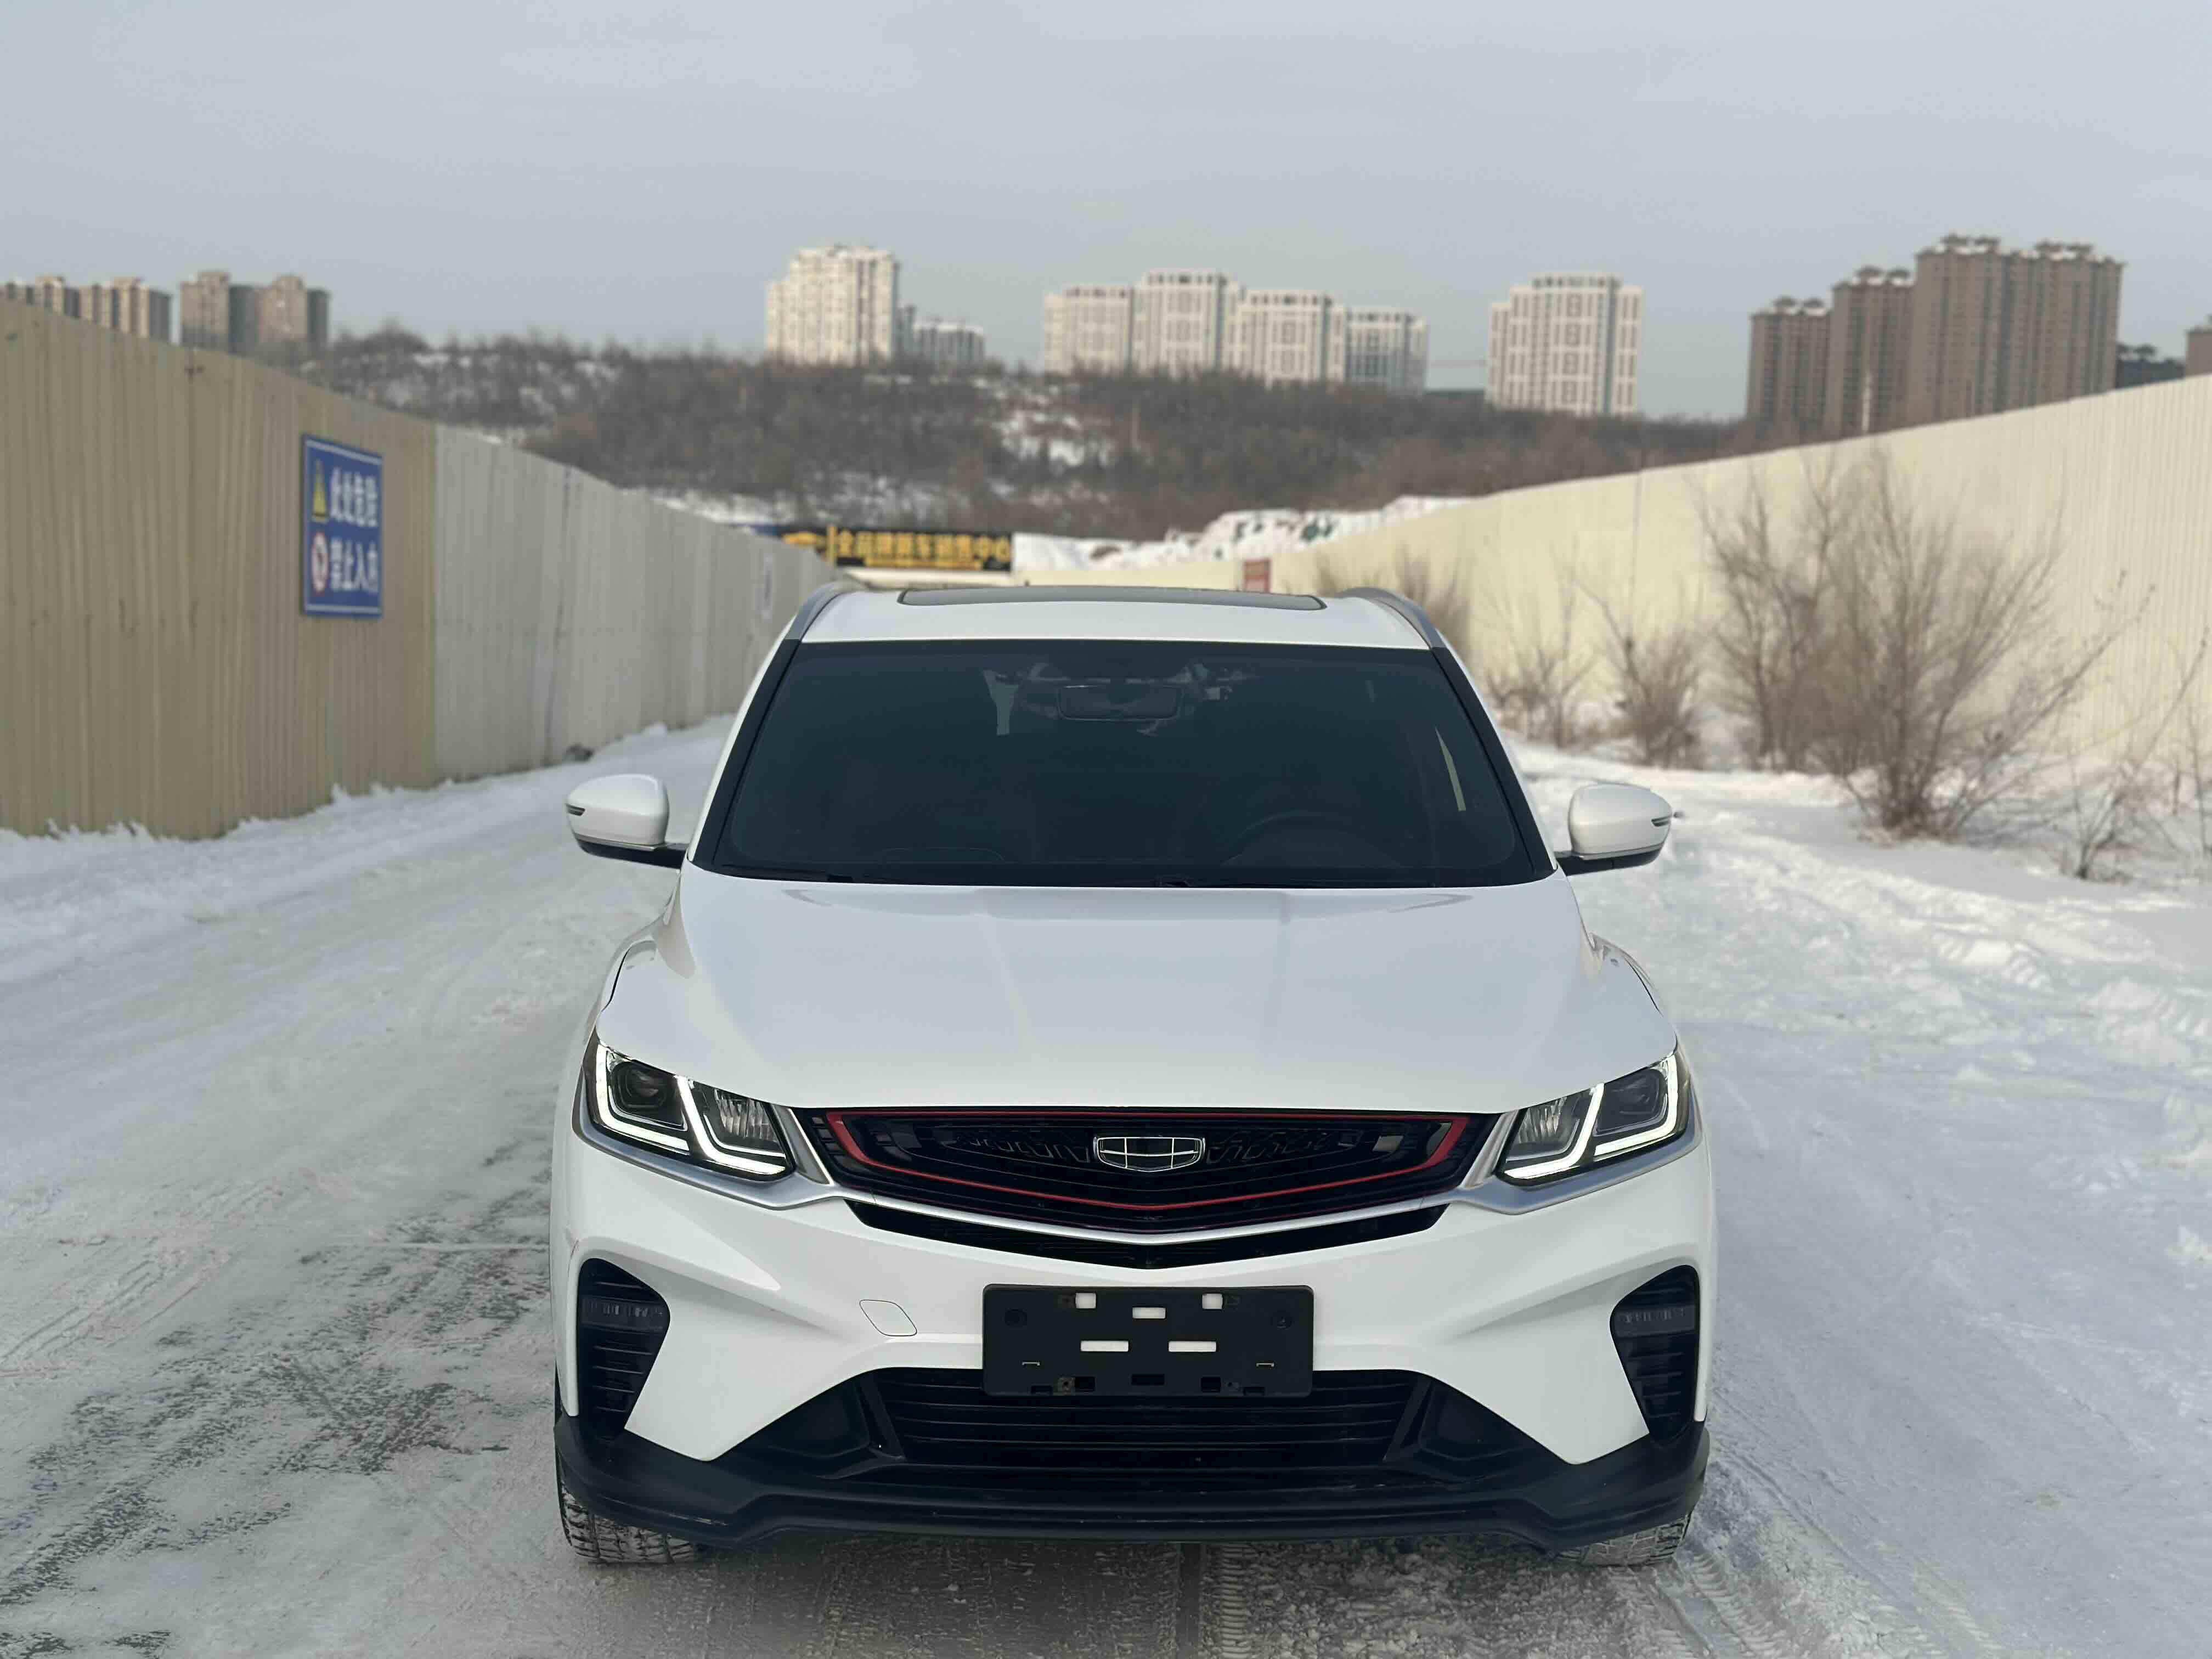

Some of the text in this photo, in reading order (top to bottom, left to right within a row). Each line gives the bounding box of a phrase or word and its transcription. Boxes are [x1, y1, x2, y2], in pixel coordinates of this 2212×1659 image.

[329, 466, 378, 527] 此处危险
[329, 537, 378, 594] 禁止入内
